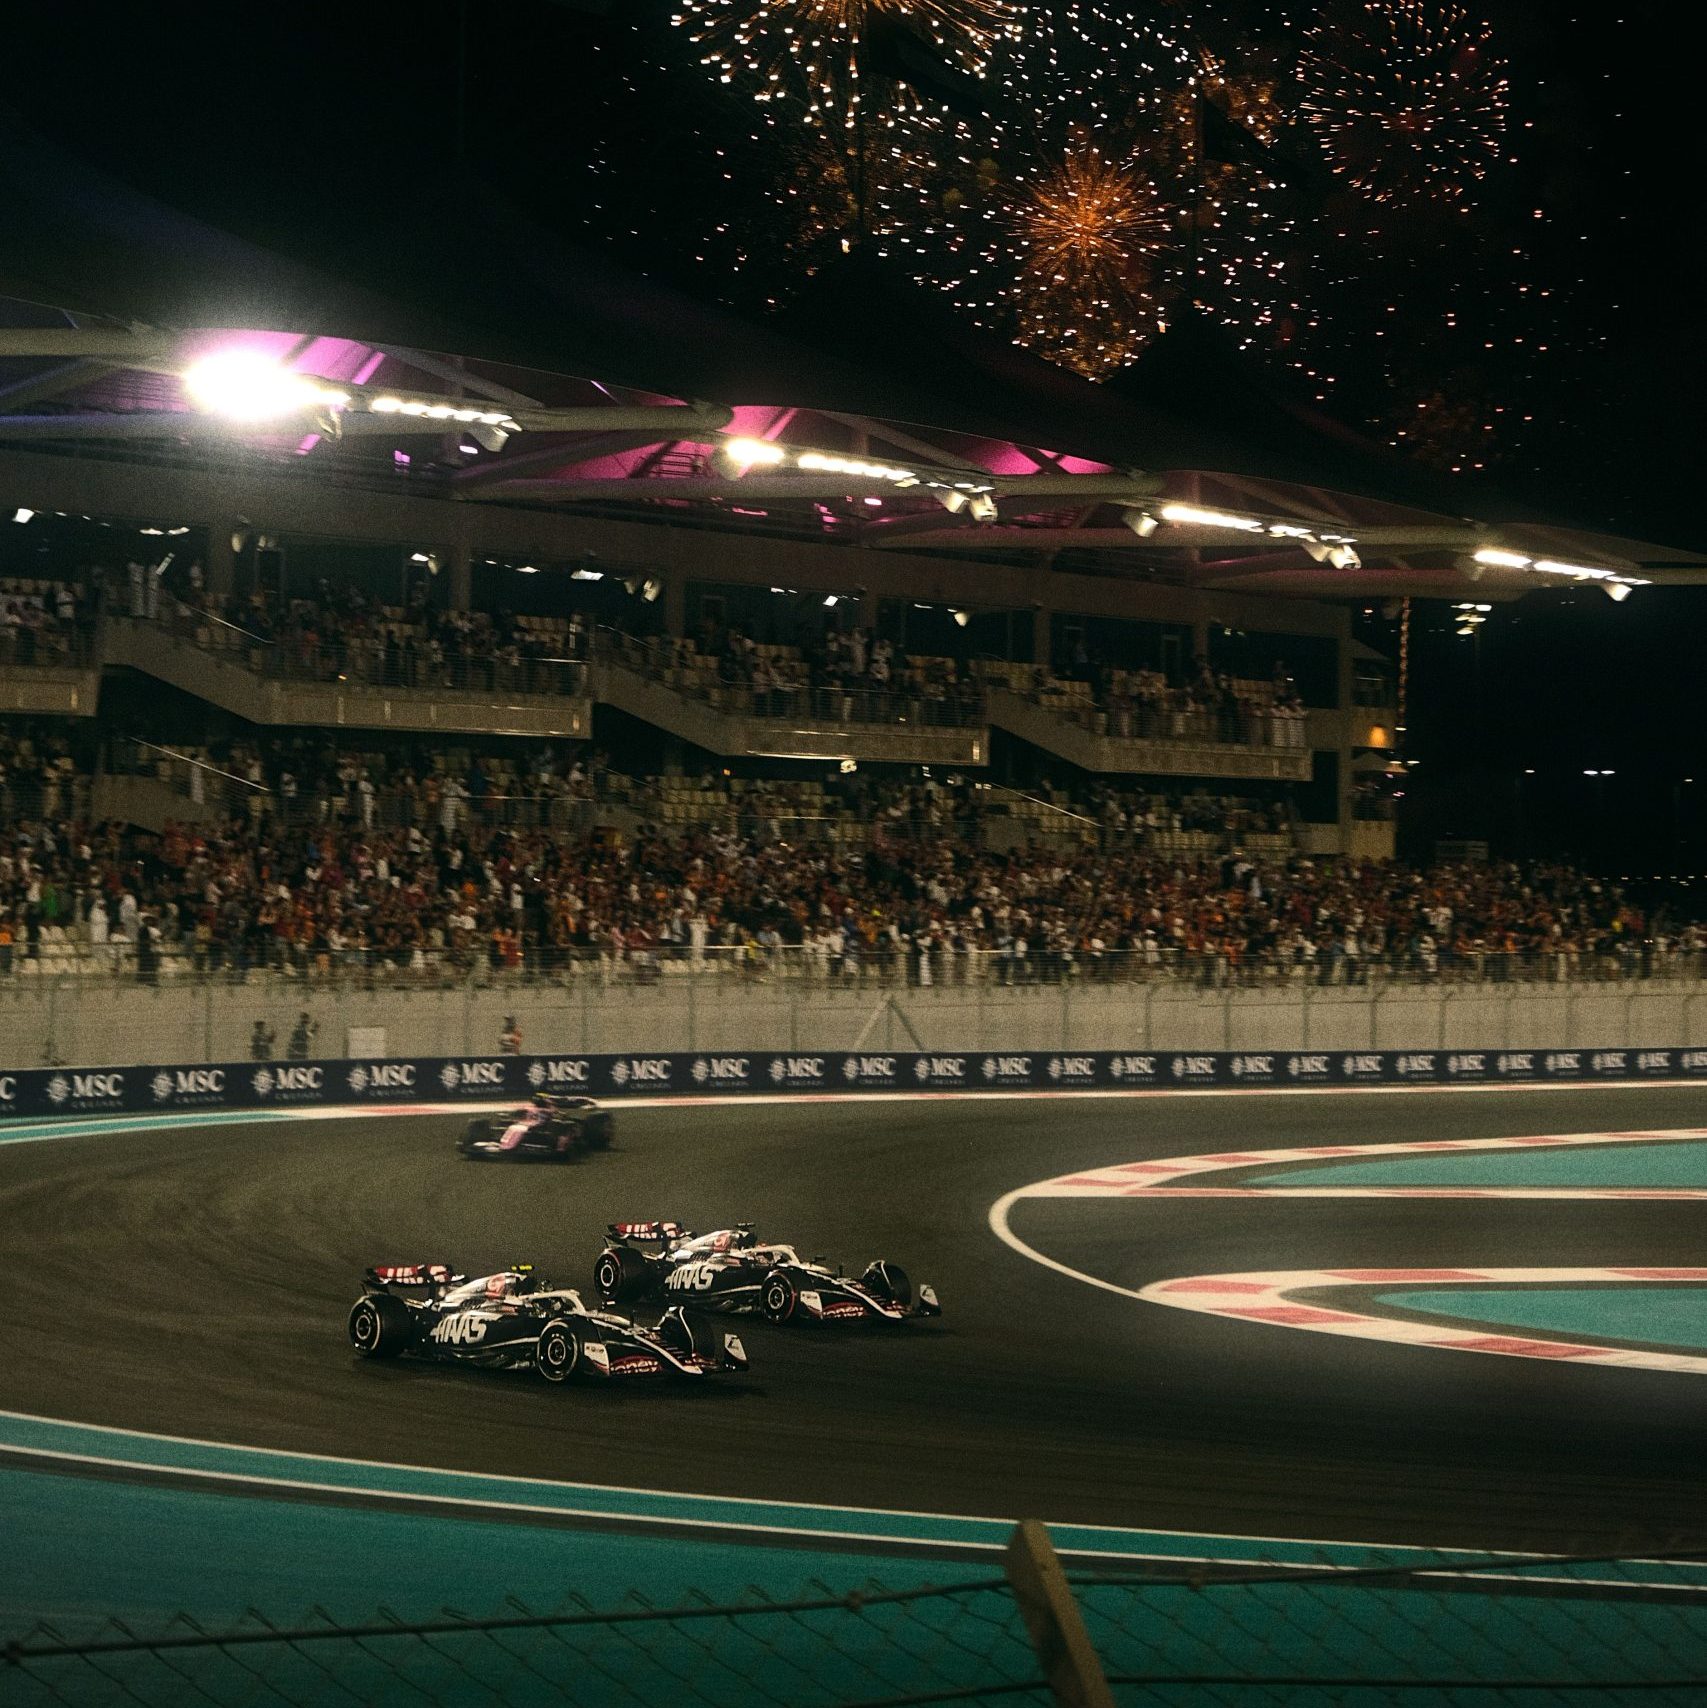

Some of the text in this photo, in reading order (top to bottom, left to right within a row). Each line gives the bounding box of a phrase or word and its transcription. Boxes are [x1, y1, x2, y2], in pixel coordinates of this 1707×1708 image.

[461, 1062, 505, 1084] MSC
[547, 1060, 590, 1082] MSC
[632, 1059, 672, 1080] MSC
[710, 1058, 750, 1078] MSC
[787, 1058, 824, 1077] MSC
[860, 1057, 897, 1076] MSC
[930, 1057, 966, 1076] MSC
[998, 1057, 1032, 1075] MSC
[1063, 1057, 1096, 1075] MSC
[1125, 1056, 1157, 1074] MSC
[1186, 1057, 1218, 1074] MSC
[1246, 1056, 1276, 1073] MSC
[1301, 1056, 1330, 1073] MSC
[176, 1070, 225, 1094] MSC
[276, 1067, 323, 1090] MSC
[370, 1064, 416, 1086] MSC
[72, 1074, 124, 1097] MSC
[430, 1314, 487, 1345] HAAS
